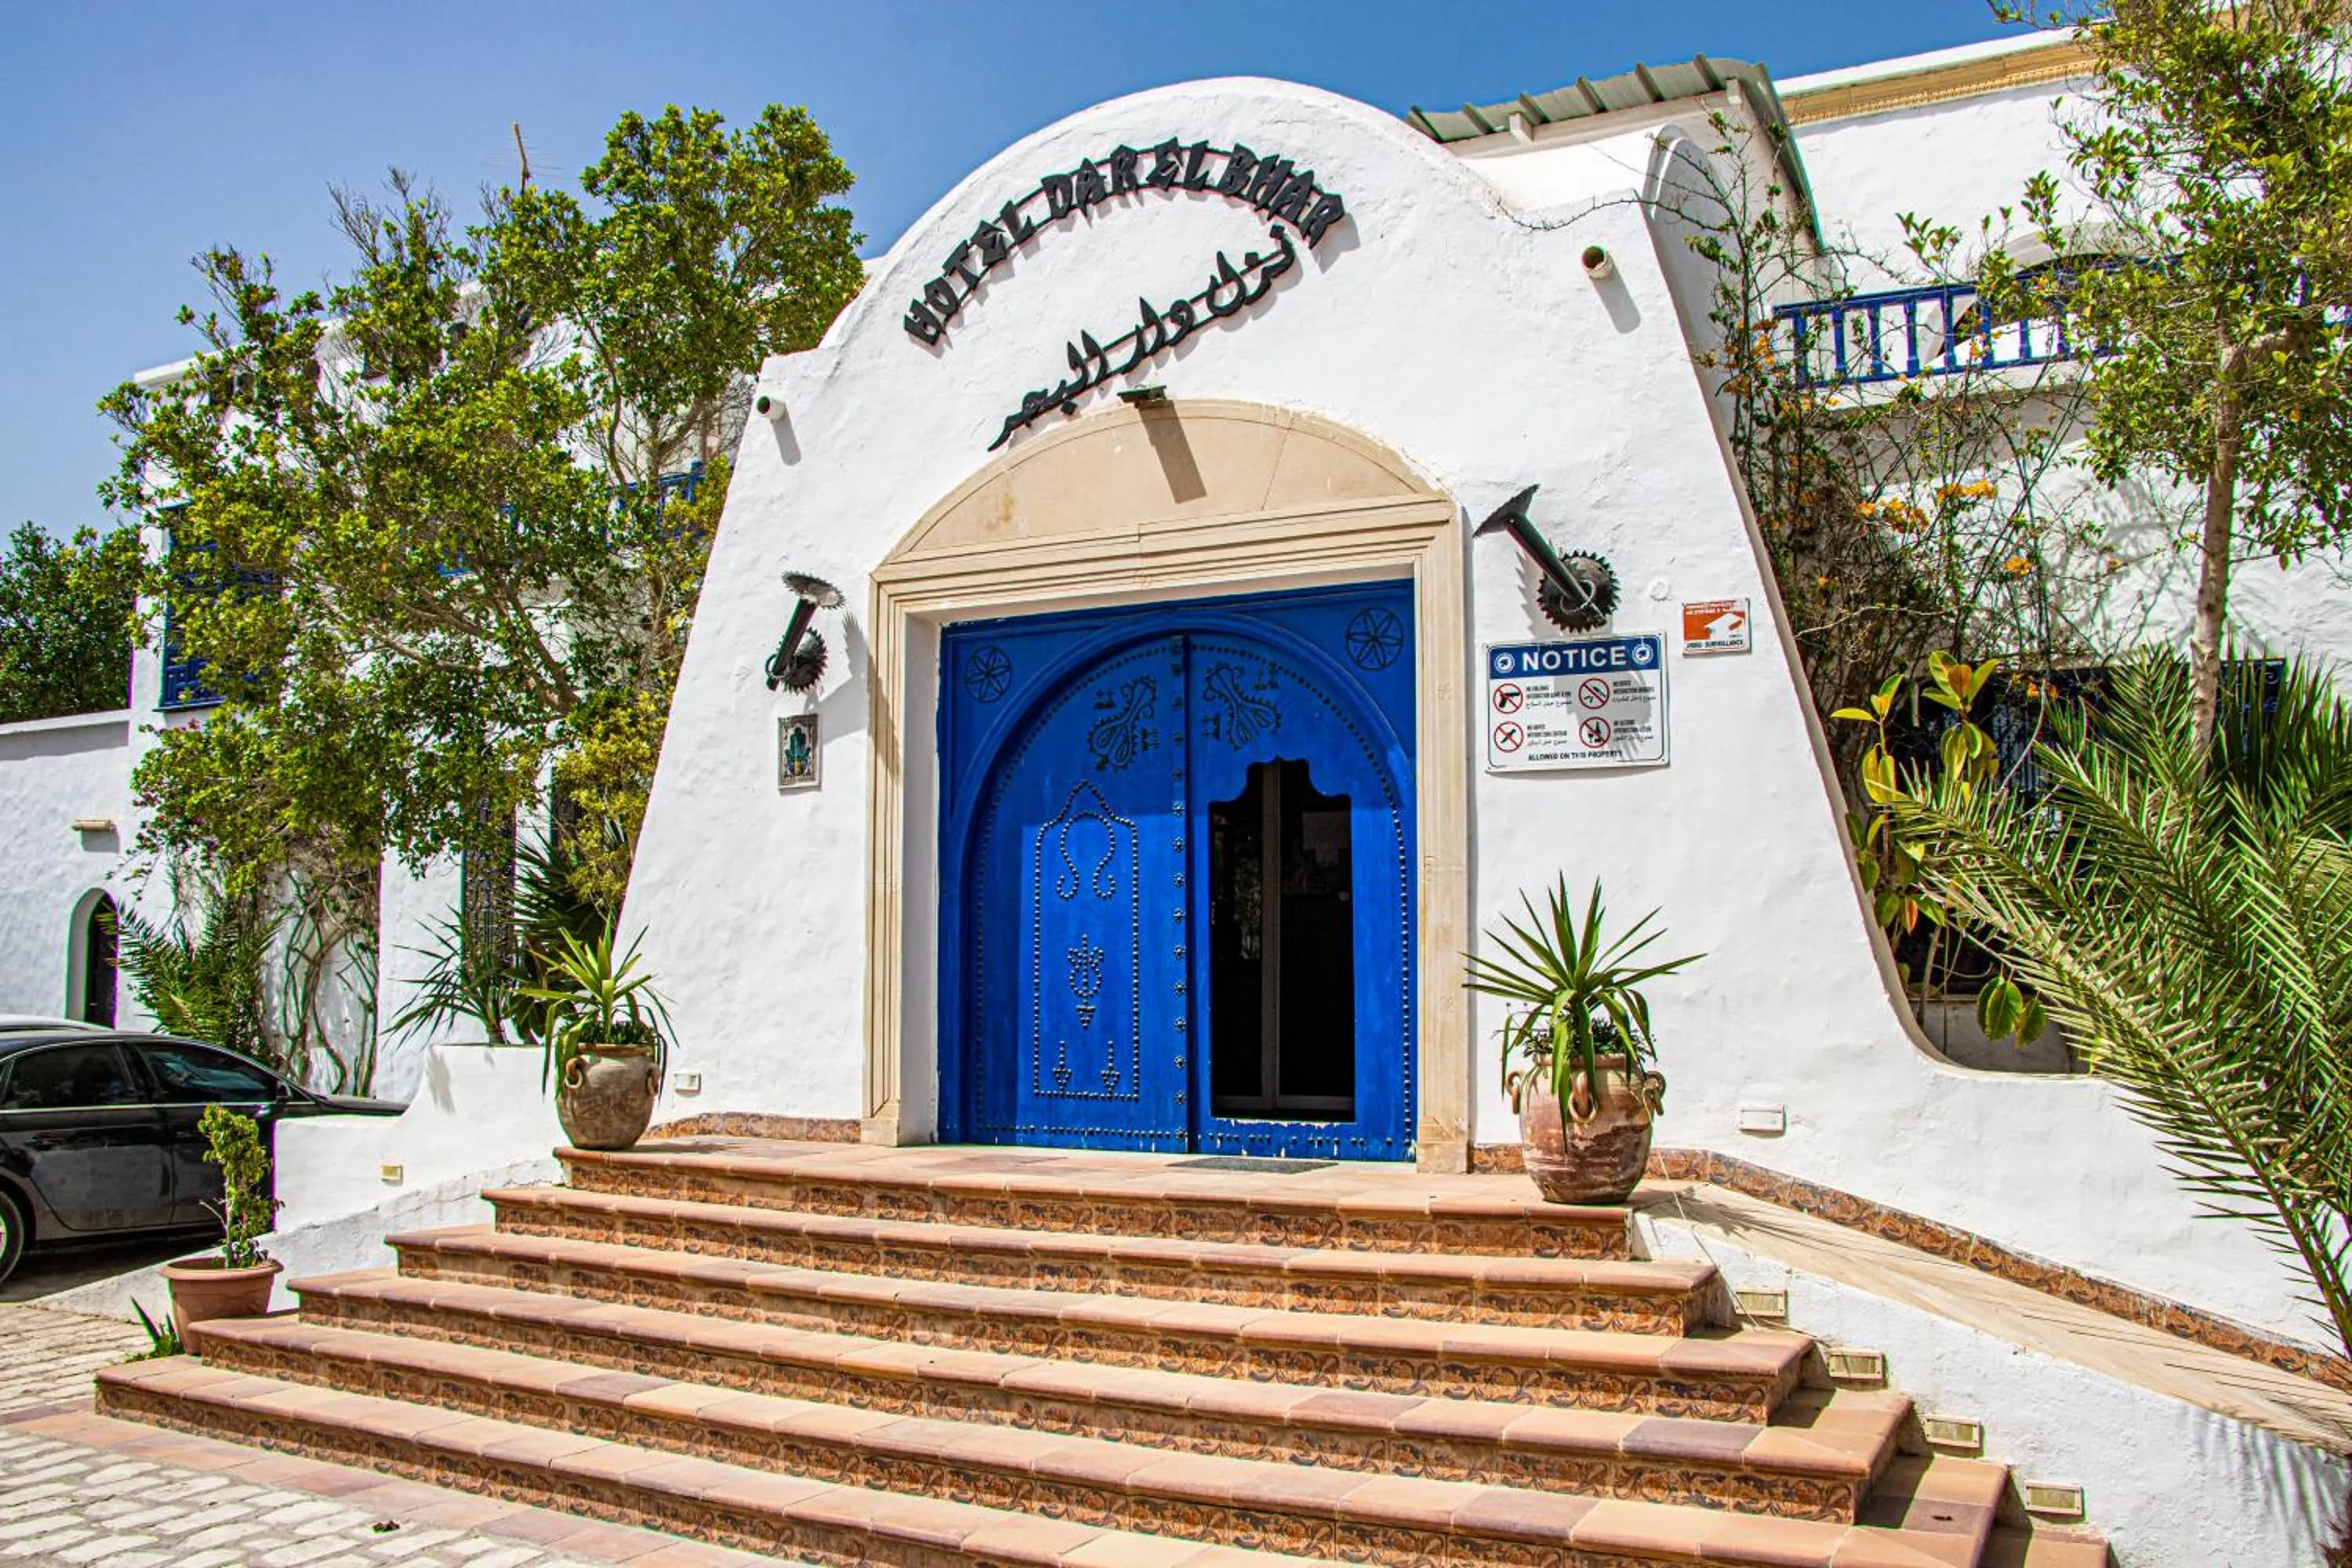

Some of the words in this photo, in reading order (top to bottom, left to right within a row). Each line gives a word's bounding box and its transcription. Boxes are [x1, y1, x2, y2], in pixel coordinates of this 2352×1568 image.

[904, 201, 1036, 346] HOTEL
[1041, 143, 1139, 218] DAR
[1523, 645, 1628, 671] NOTICE
